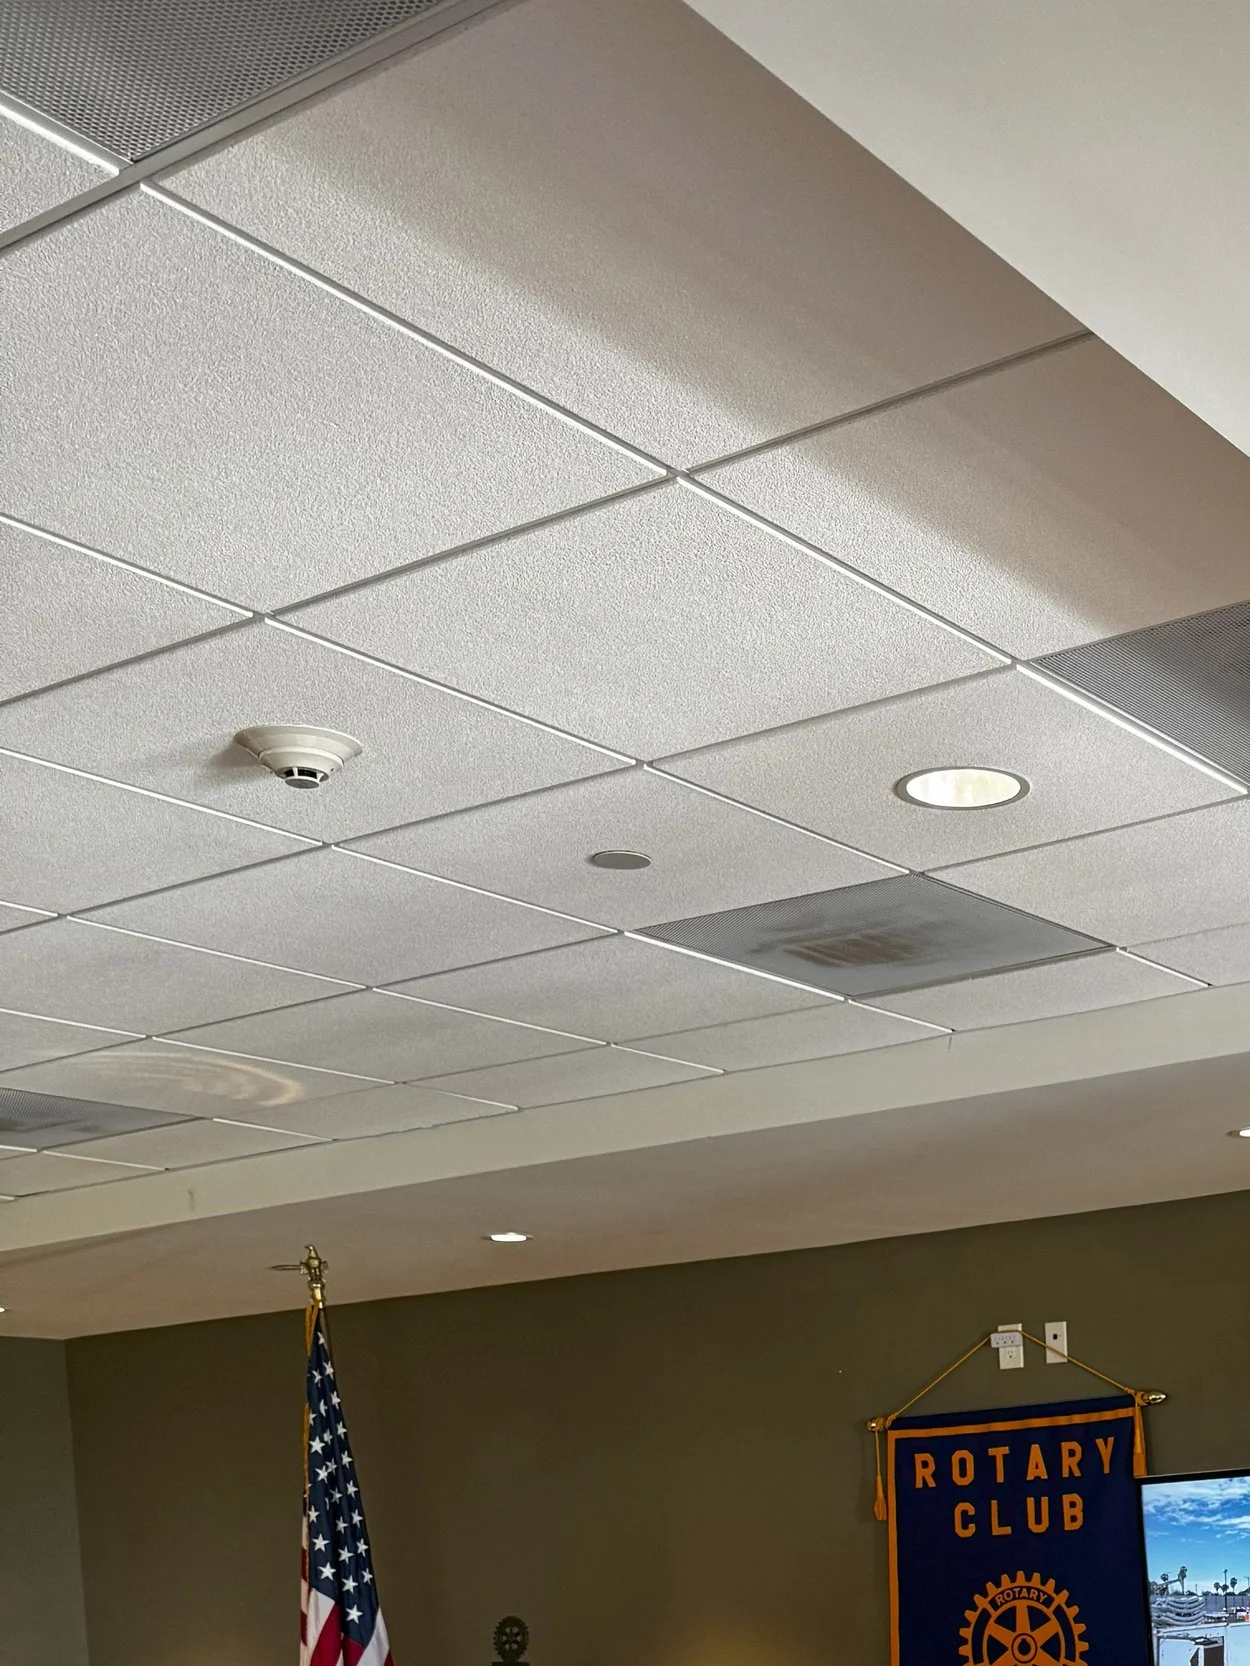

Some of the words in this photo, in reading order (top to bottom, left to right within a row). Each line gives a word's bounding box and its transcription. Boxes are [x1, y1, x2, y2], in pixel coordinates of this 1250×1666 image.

[914, 1437, 1115, 1489] ROTARY
[954, 1493, 1084, 1538] CLUB
[995, 1587, 1048, 1606] ROTARY
